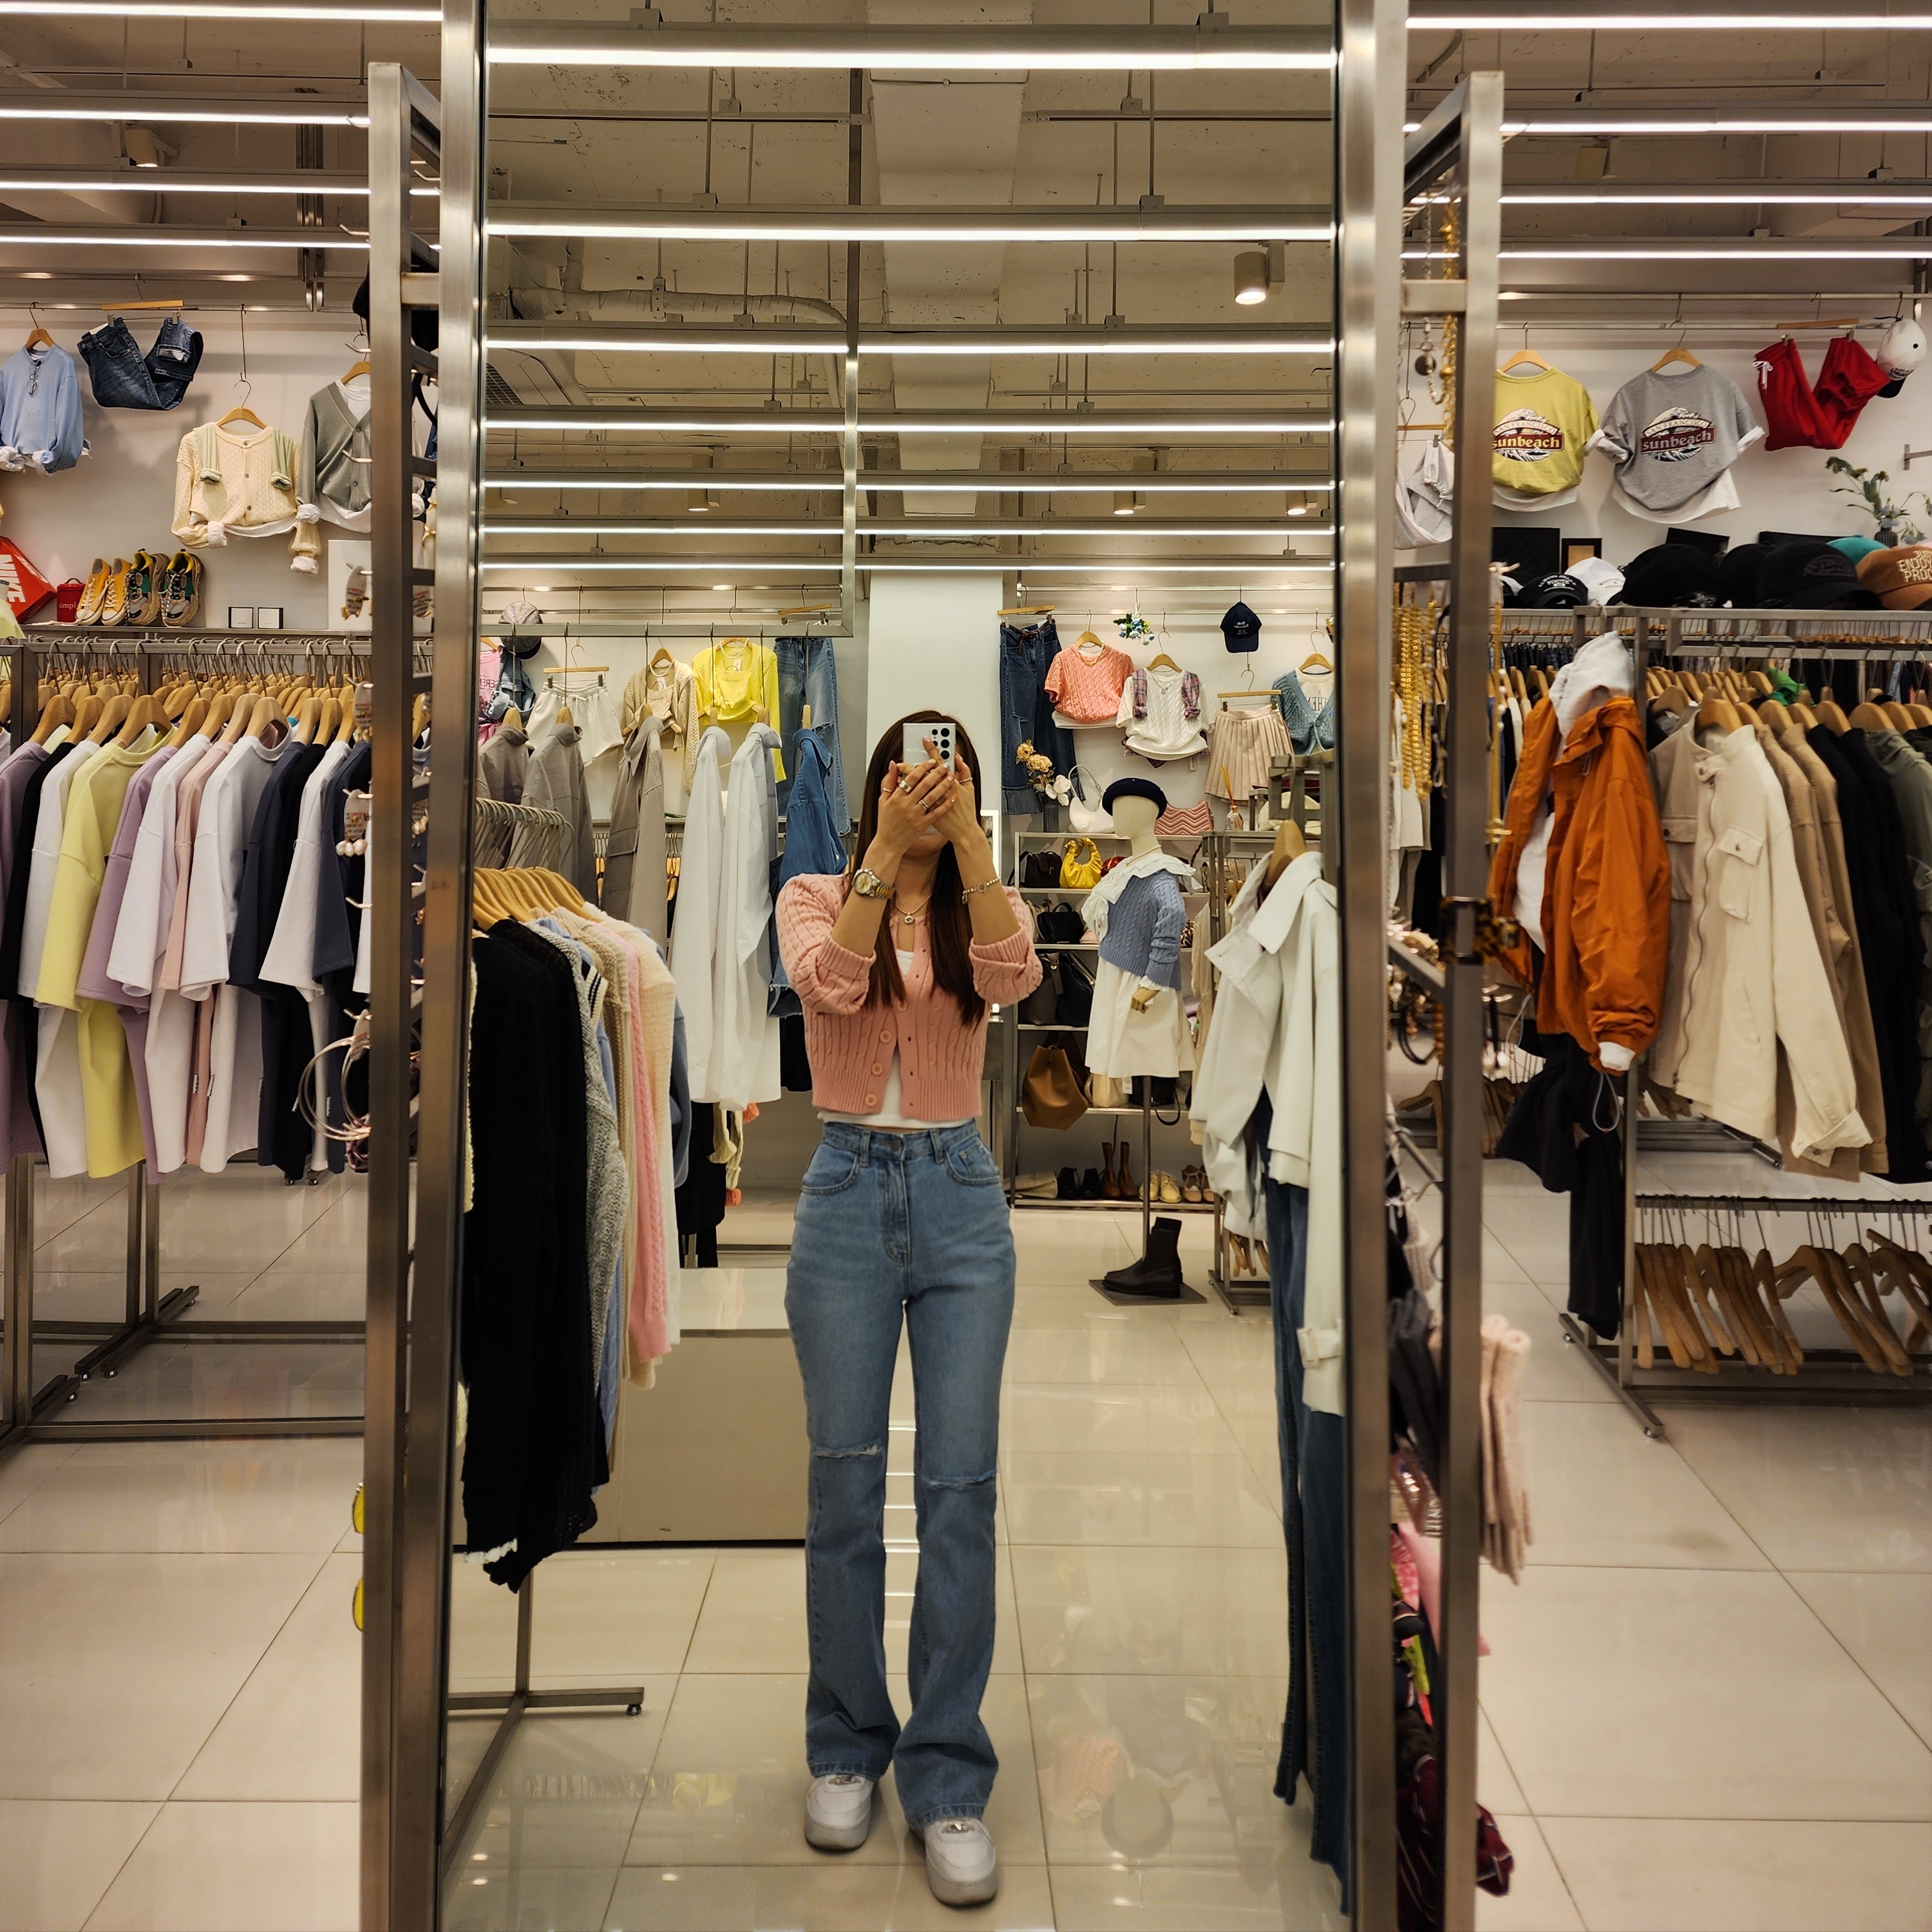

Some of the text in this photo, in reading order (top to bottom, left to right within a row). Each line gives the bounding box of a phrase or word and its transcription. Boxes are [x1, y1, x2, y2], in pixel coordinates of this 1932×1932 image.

[1511, 421, 1556, 434] FRANCISCO
[1492, 436, 1560, 449] sunbeach
[1643, 430, 1712, 450] sunbeach
